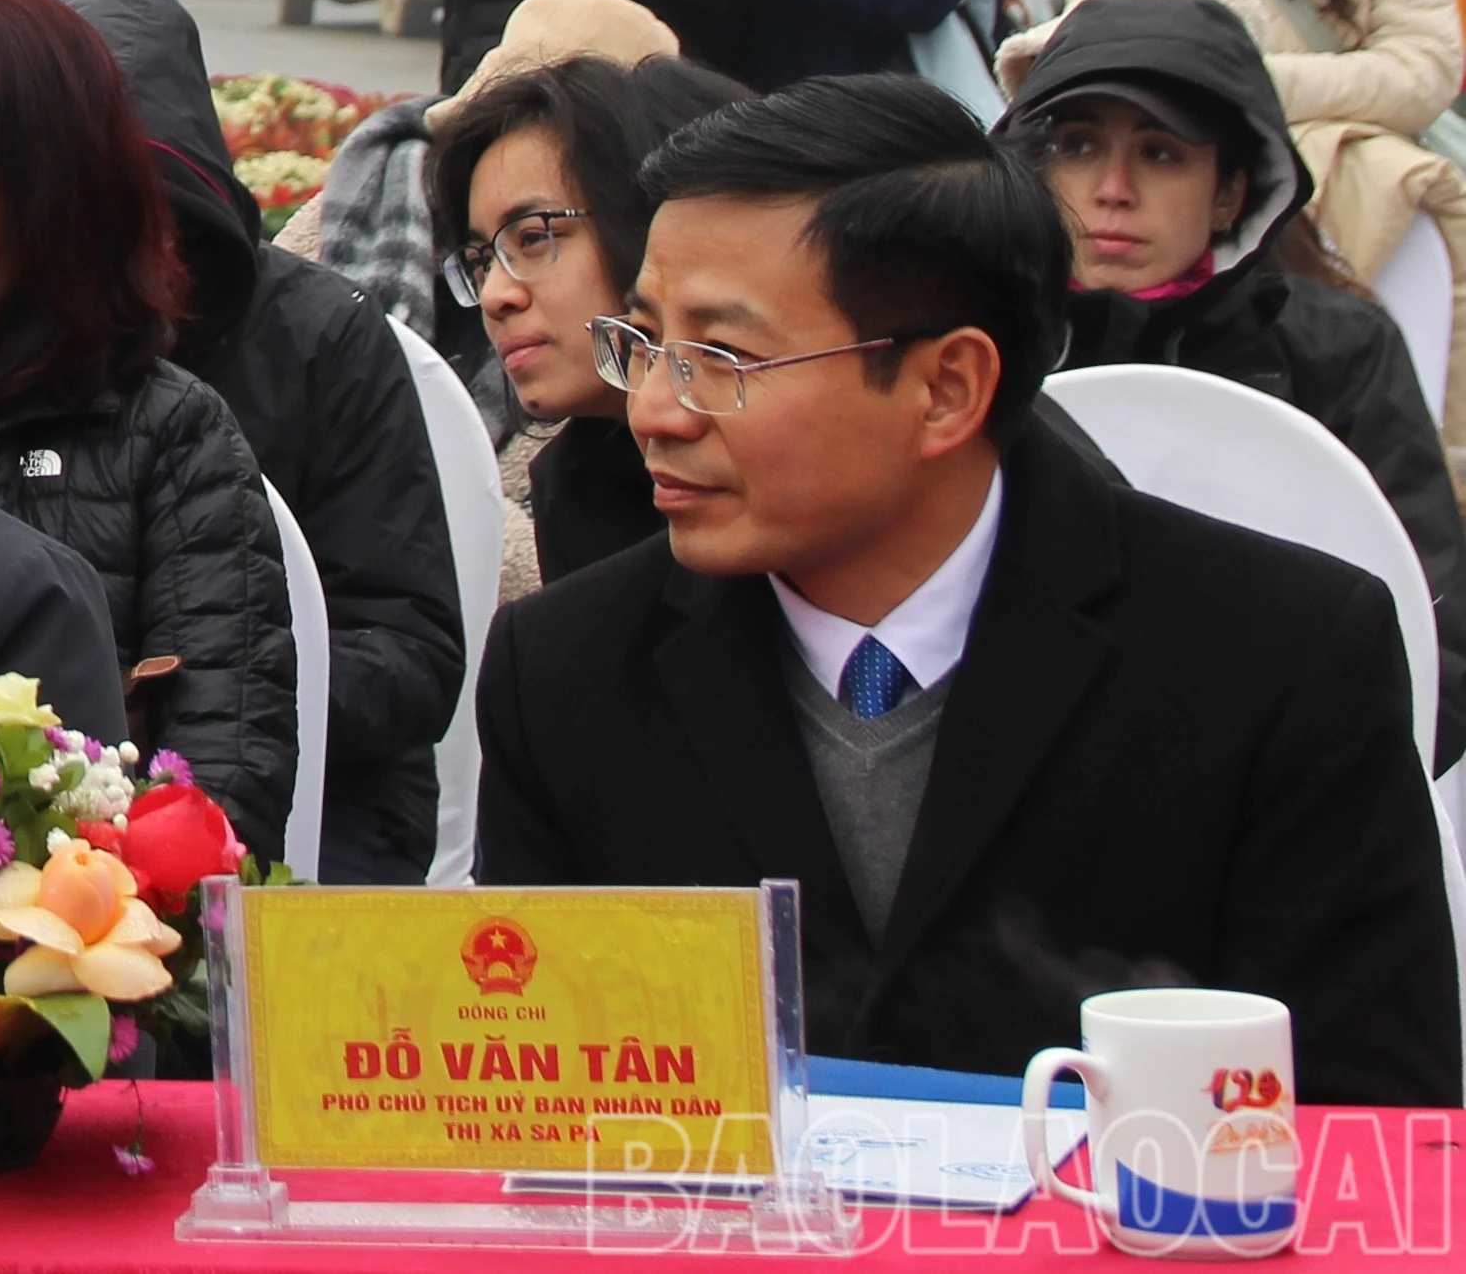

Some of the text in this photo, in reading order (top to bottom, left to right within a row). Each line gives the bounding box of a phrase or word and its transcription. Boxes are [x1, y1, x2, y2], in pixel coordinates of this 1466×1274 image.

[516, 1004, 546, 1020] CHÍ
[343, 1027, 696, 1084] ĐỖ VĂN TÂN
[322, 1092, 369, 1112] PHÓ
[378, 1089, 426, 1112] CHỦ
[434, 1095, 488, 1119] TỊCH
[534, 1097, 585, 1115] BAN
[593, 1094, 662, 1116] NHÂN
[671, 1096, 722, 1116] DÂN
[1202, 1067, 1283, 1113] 120
[443, 1120, 601, 1144] THỊ XÃ SA PA
